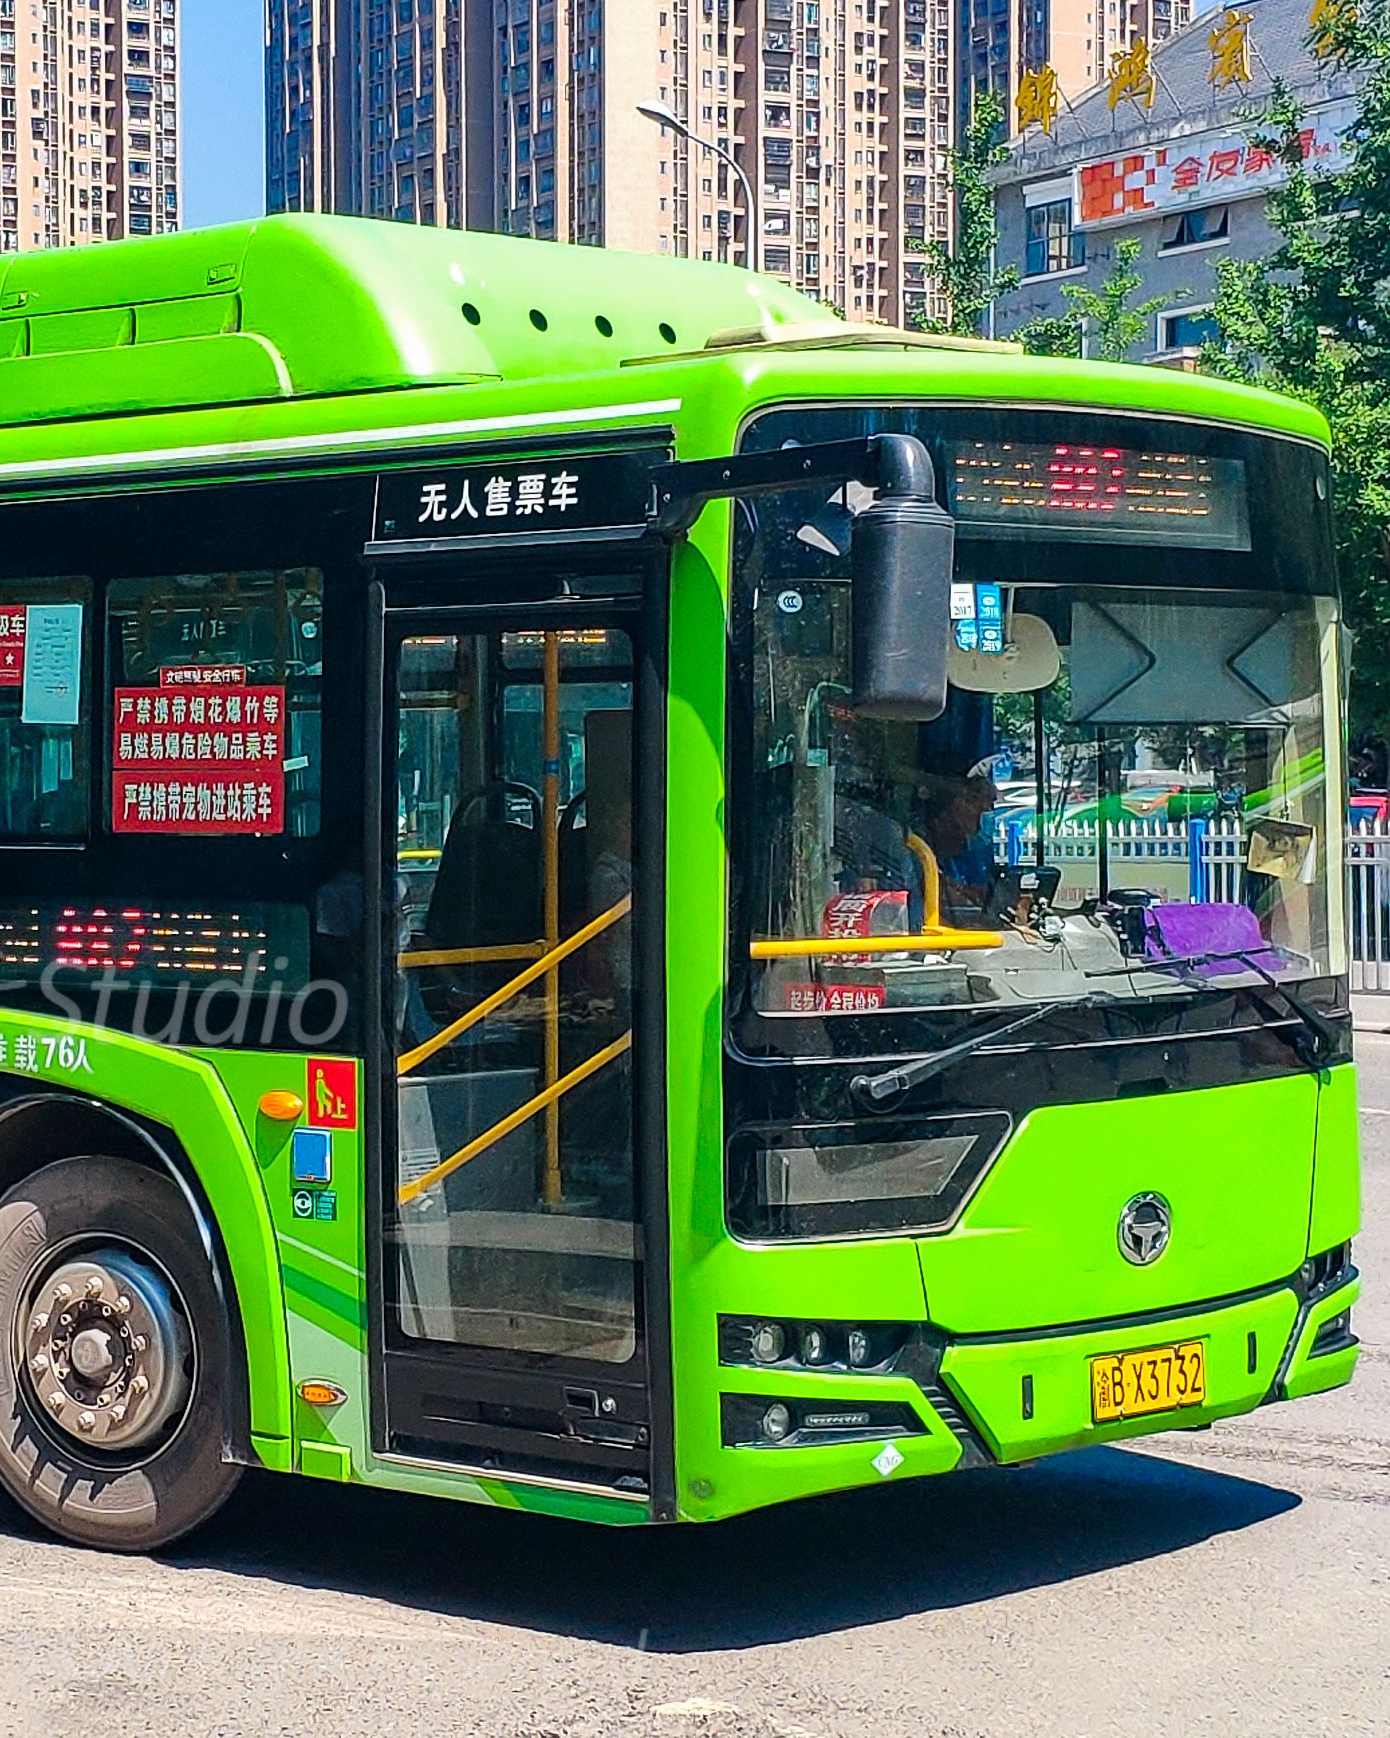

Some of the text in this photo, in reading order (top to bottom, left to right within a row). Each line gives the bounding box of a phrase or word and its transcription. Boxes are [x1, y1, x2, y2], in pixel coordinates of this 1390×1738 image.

[418, 470, 579, 523] 无人售票车
[118, 695, 280, 725] 严禁携带烟花爆竹等
[118, 732, 279, 761] 易燃易爆危险物品乘车
[123, 782, 273, 823] 严禁携带宠物进站乘车
[330, 1095, 348, 1119] 上
